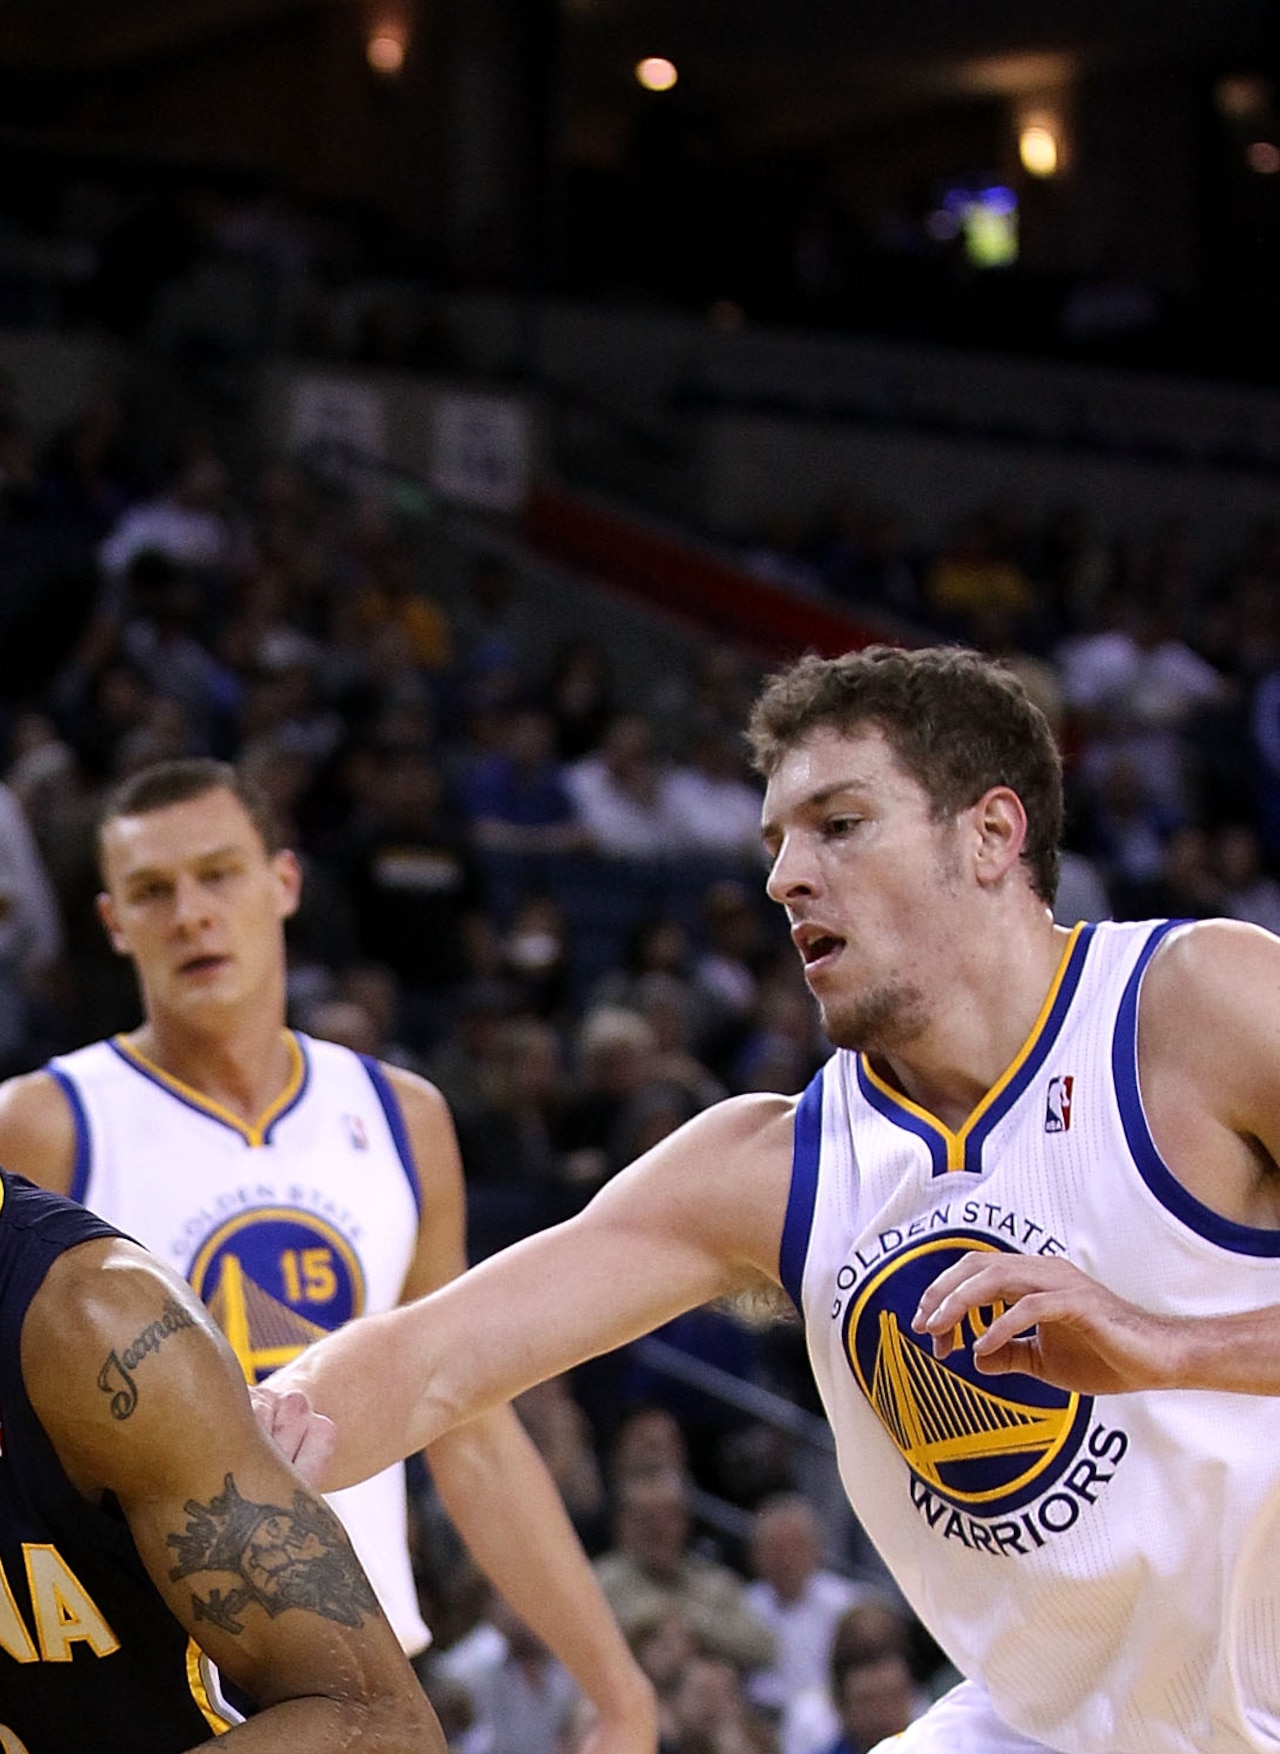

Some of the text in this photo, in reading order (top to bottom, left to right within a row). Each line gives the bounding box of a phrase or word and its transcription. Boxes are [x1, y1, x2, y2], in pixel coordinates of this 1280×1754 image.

[962, 1201, 1067, 1256] STATE
[280, 1247, 337, 1303] 15
[909, 1423, 1129, 1557] WARRIORS
